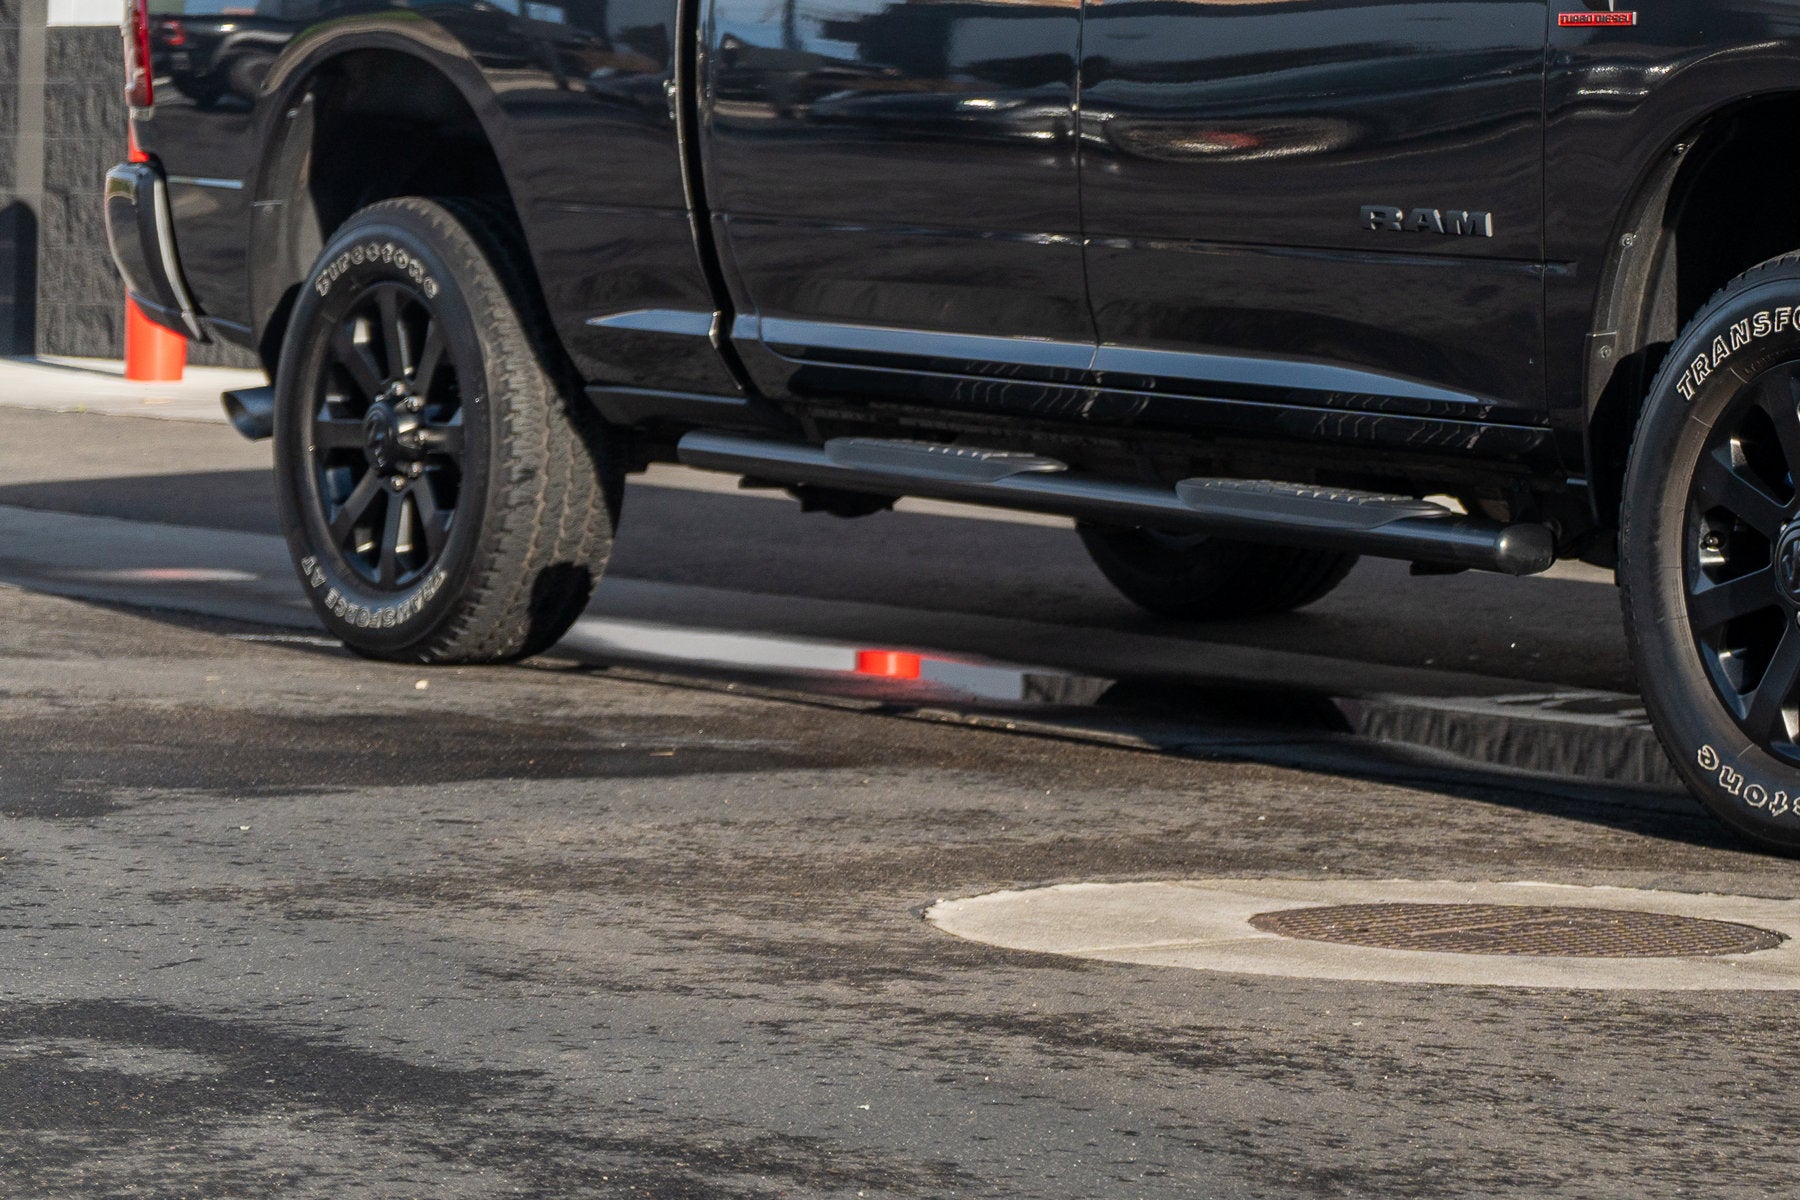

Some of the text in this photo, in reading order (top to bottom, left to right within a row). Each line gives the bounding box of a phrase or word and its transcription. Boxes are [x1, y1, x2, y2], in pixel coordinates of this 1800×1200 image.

[1596, 14, 1630, 24] DIESEL
[1360, 205, 1494, 238] RAM
[301, 555, 327, 588] AT
